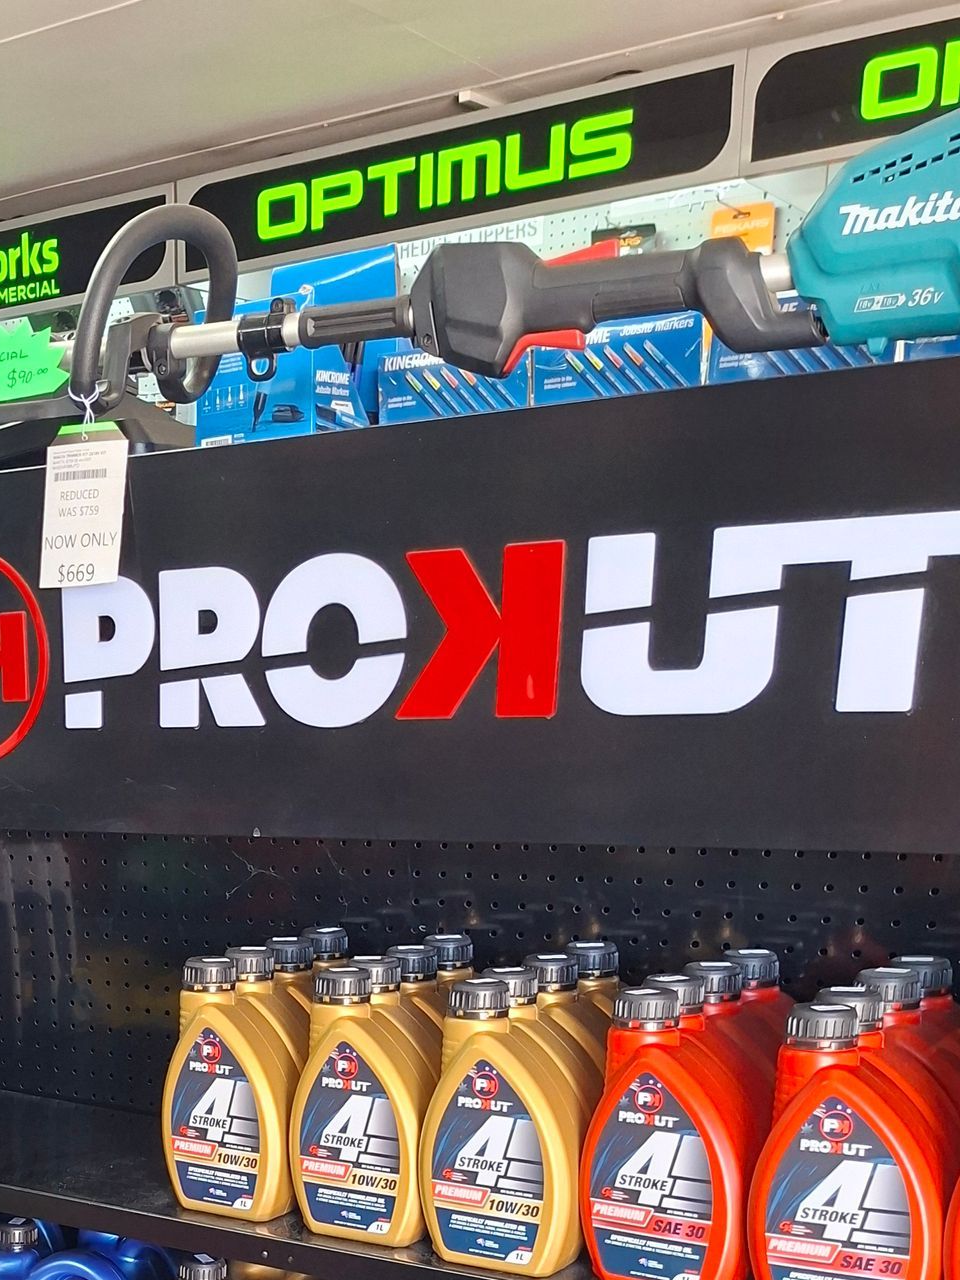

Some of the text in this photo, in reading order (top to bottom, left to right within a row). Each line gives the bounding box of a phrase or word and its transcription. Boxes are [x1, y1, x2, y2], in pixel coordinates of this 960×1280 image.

[257, 107, 634, 244] OPTIMUS
[654, 317, 694, 332] Markers
[316, 370, 350, 385] KINCROME
[60, 489, 99, 501] REDUCED
[58, 505, 99, 517] WAS $759
[44, 532, 118, 550] NOW ONLY
[58, 563, 95, 583] $669
[62, 512, 960, 730] PROKUT
[189, 1061, 233, 1075] PROKUT
[321, 1077, 372, 1093] PROKUT
[189, 1078, 235, 1142] 4
[457, 1096, 514, 1113] PROKUT
[192, 1115, 227, 1129] STROKE
[321, 1094, 373, 1162] 4
[618, 1110, 680, 1129] PROKUT
[174, 1140, 212, 1155] PREMIUM
[323, 1133, 364, 1149] STROKE
[799, 1138, 872, 1158] PROKUT
[453, 1115, 513, 1187] 4
[217, 1153, 258, 1169] 10W/30
[302, 1159, 346, 1177] PREMIUM
[458, 1156, 505, 1173] STROKE
[614, 1131, 681, 1207] 4
[351, 1171, 398, 1191] 10W/30
[618, 1173, 669, 1192] STROKE
[434, 1184, 483, 1204] PREMIUM
[794, 1159, 872, 1242] 4
[488, 1198, 540, 1217] 10W/30
[592, 1202, 647, 1223] PREMIUM
[799, 1206, 860, 1225] STROKE
[653, 1219, 706, 1240] SAE 30
[768, 1237, 832, 1258] PREMIUM
[840, 1254, 903, 1275] SAE 30
